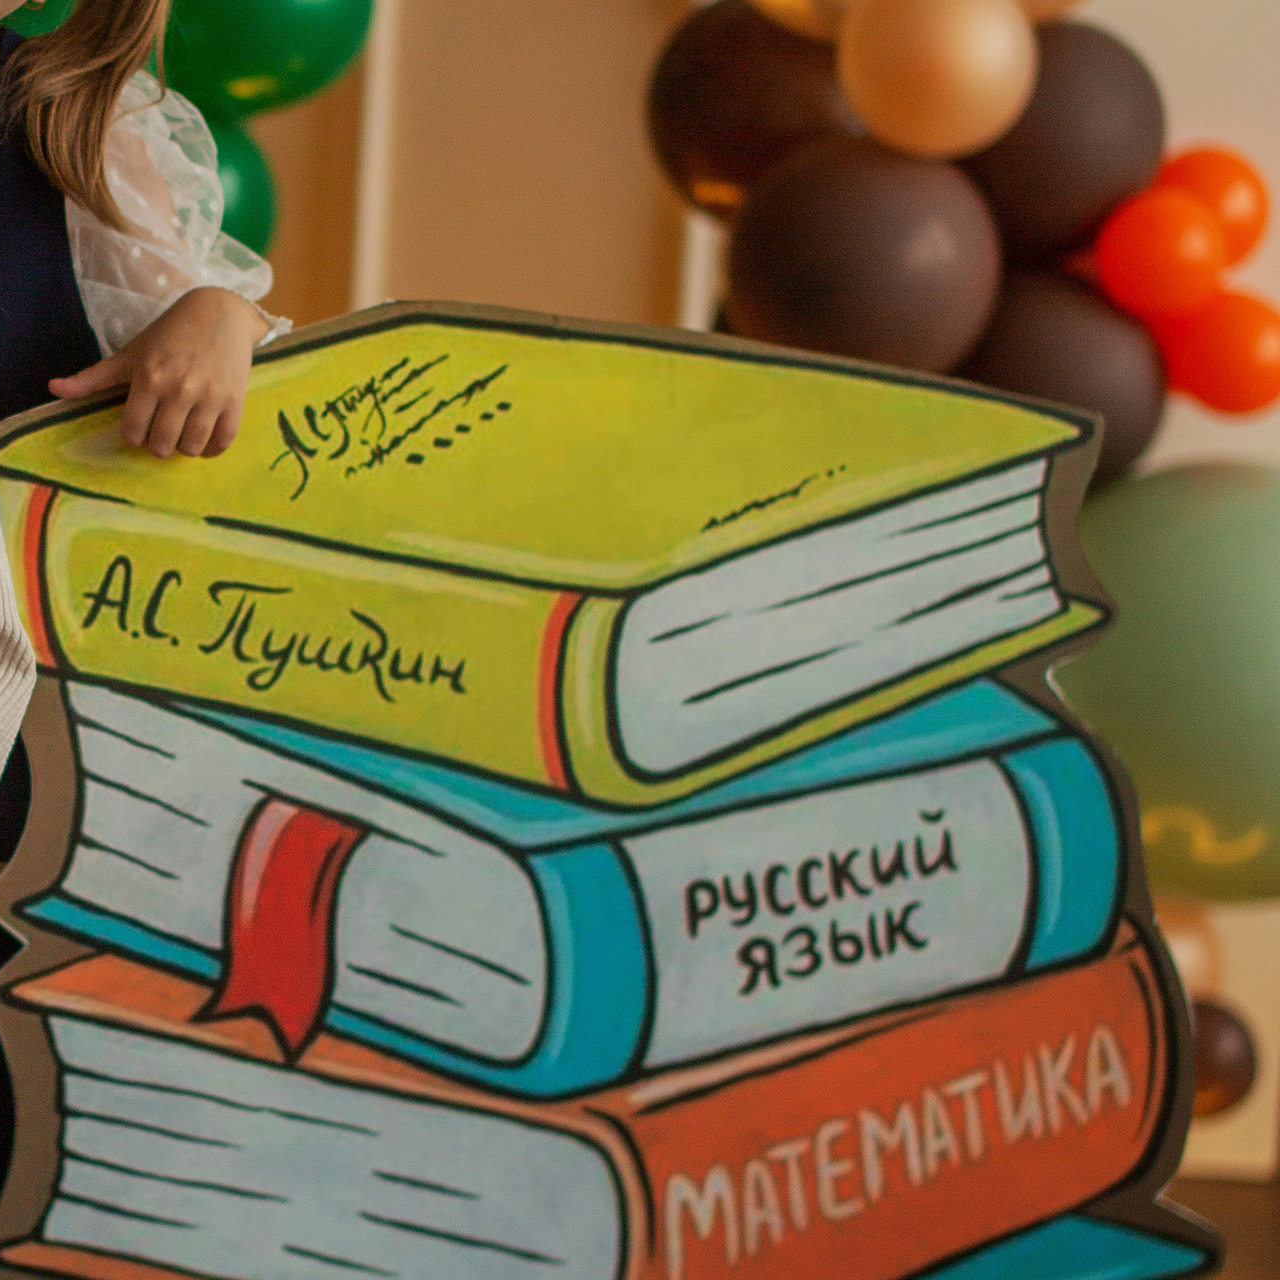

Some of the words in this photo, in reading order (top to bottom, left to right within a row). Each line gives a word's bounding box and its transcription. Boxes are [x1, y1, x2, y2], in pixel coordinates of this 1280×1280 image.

[82, 554, 181, 648] А.С.
[197, 580, 468, 704] Пушкин
[737, 901, 930, 997] ЯЗЫК
